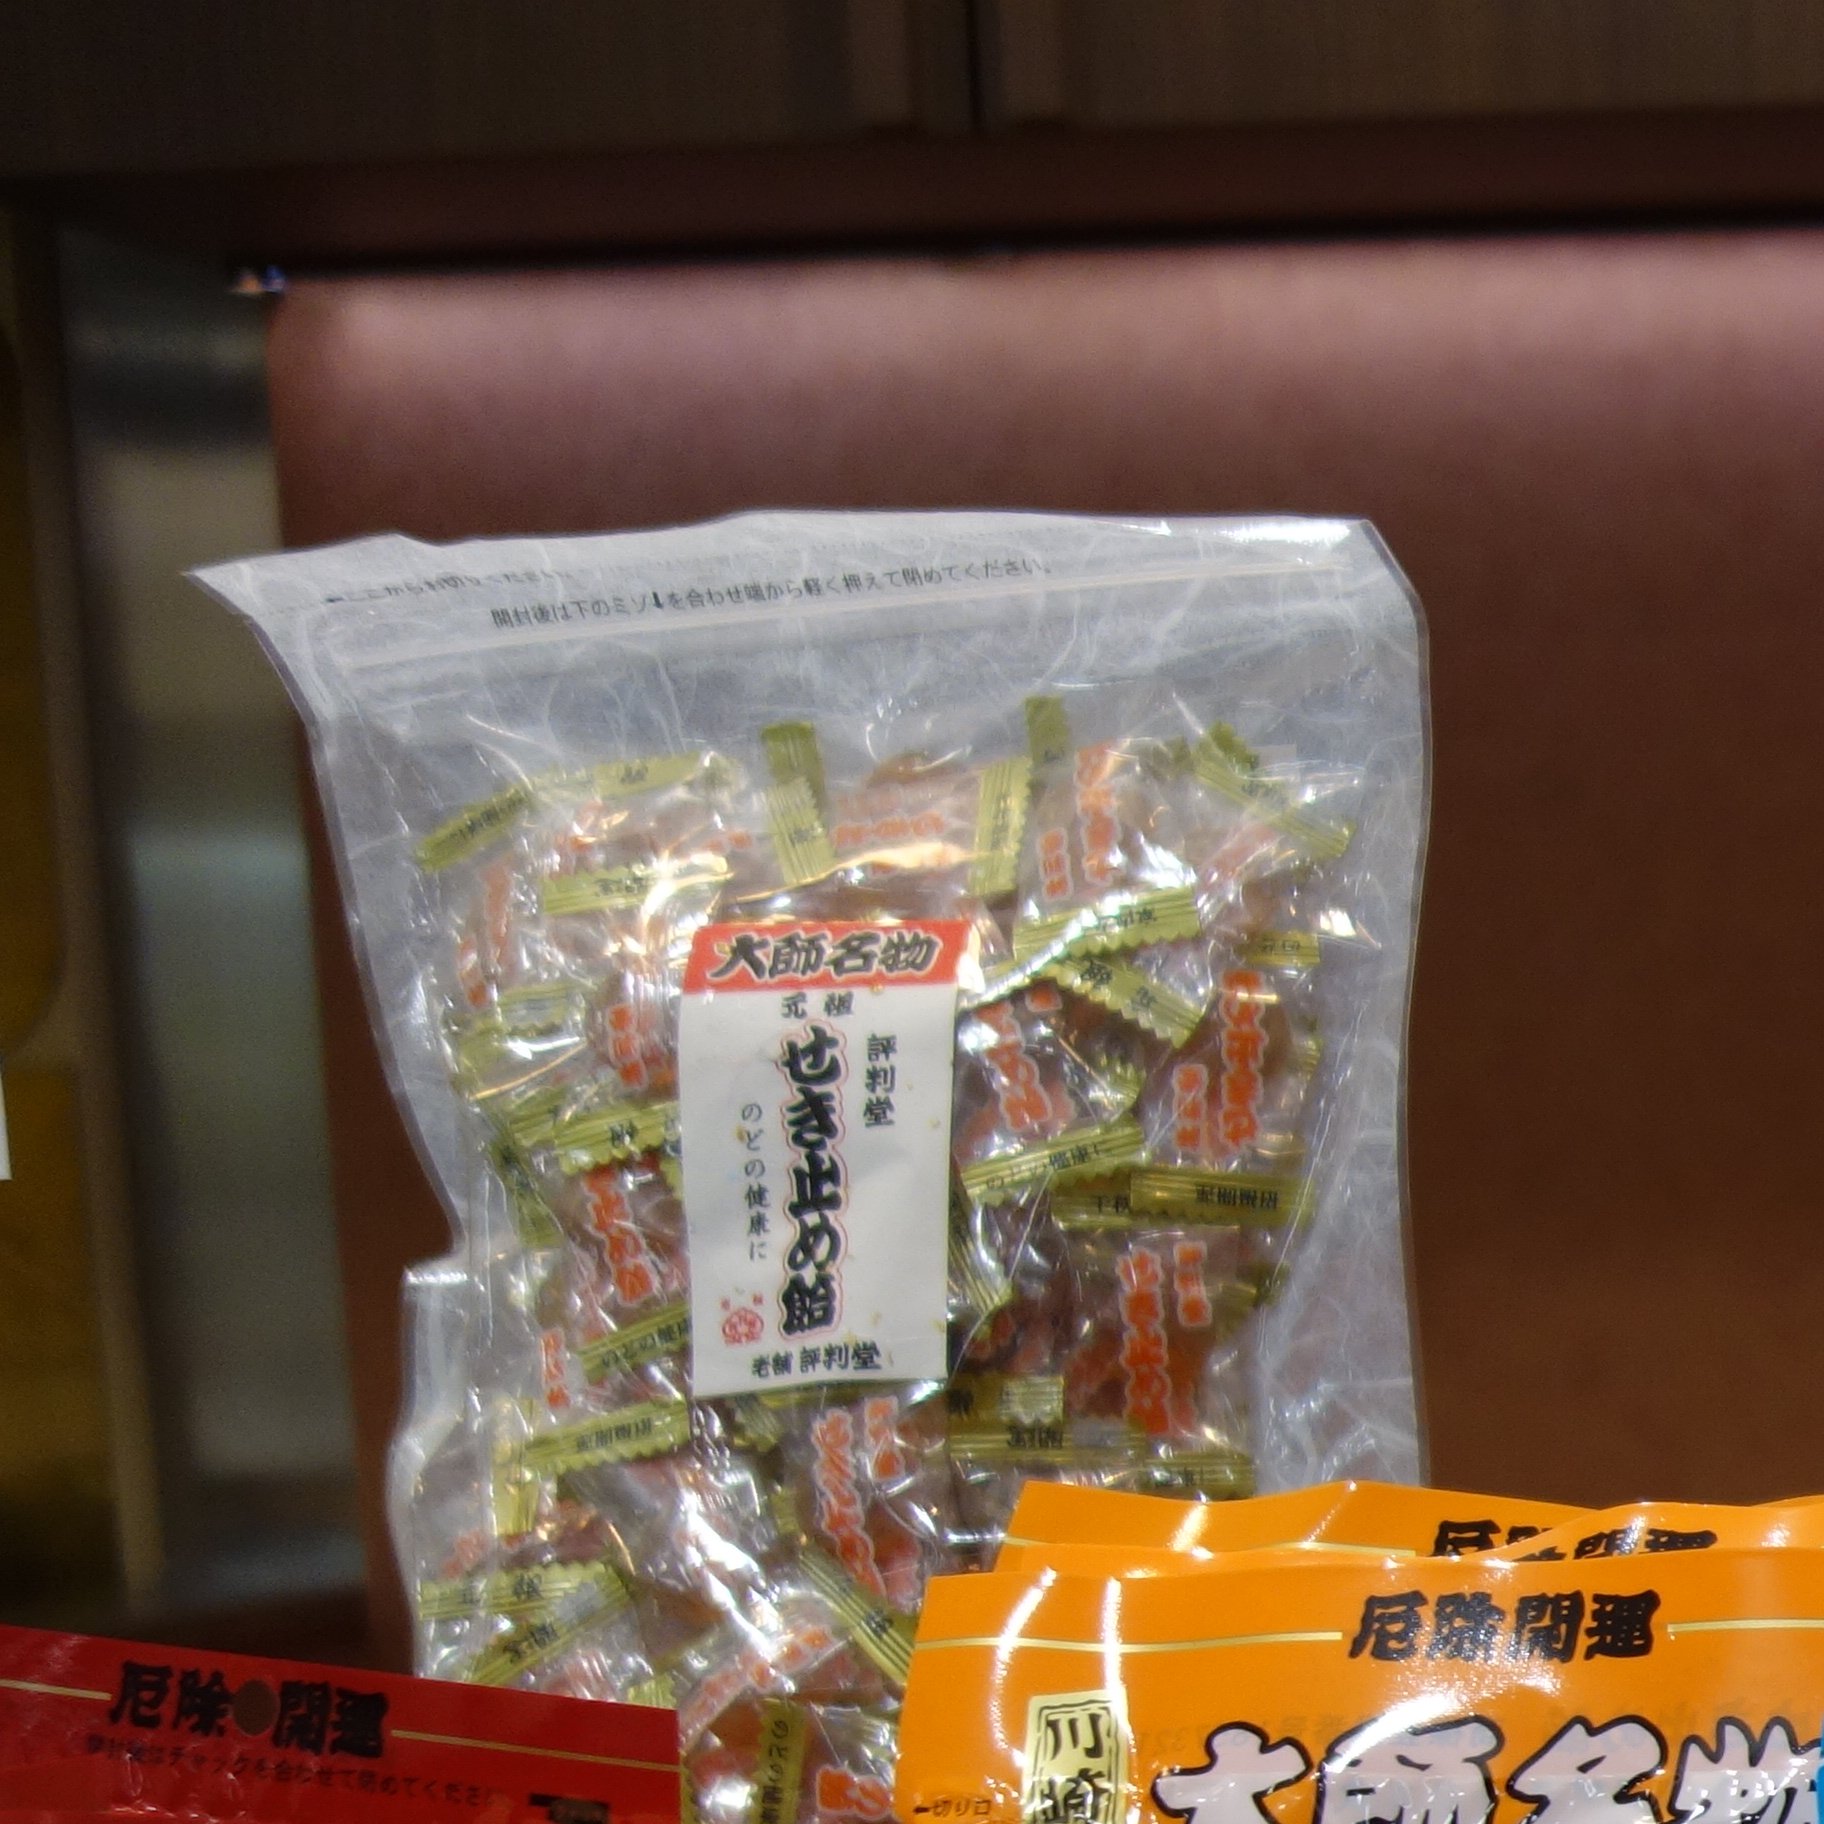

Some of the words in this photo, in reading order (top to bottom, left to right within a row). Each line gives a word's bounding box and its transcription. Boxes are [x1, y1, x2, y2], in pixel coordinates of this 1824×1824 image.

[706, 930, 942, 980] 大師名物
[782, 992, 854, 1019] 元祖
[863, 1034, 897, 1128] 評判堂
[741, 1102, 771, 1262] のどの健康に
[782, 1026, 842, 1336] せき止め飴
[752, 1352, 794, 1377] 老舗
[799, 1341, 882, 1374] 評判堂
[1348, 1589, 1662, 1664] 厄除開運
